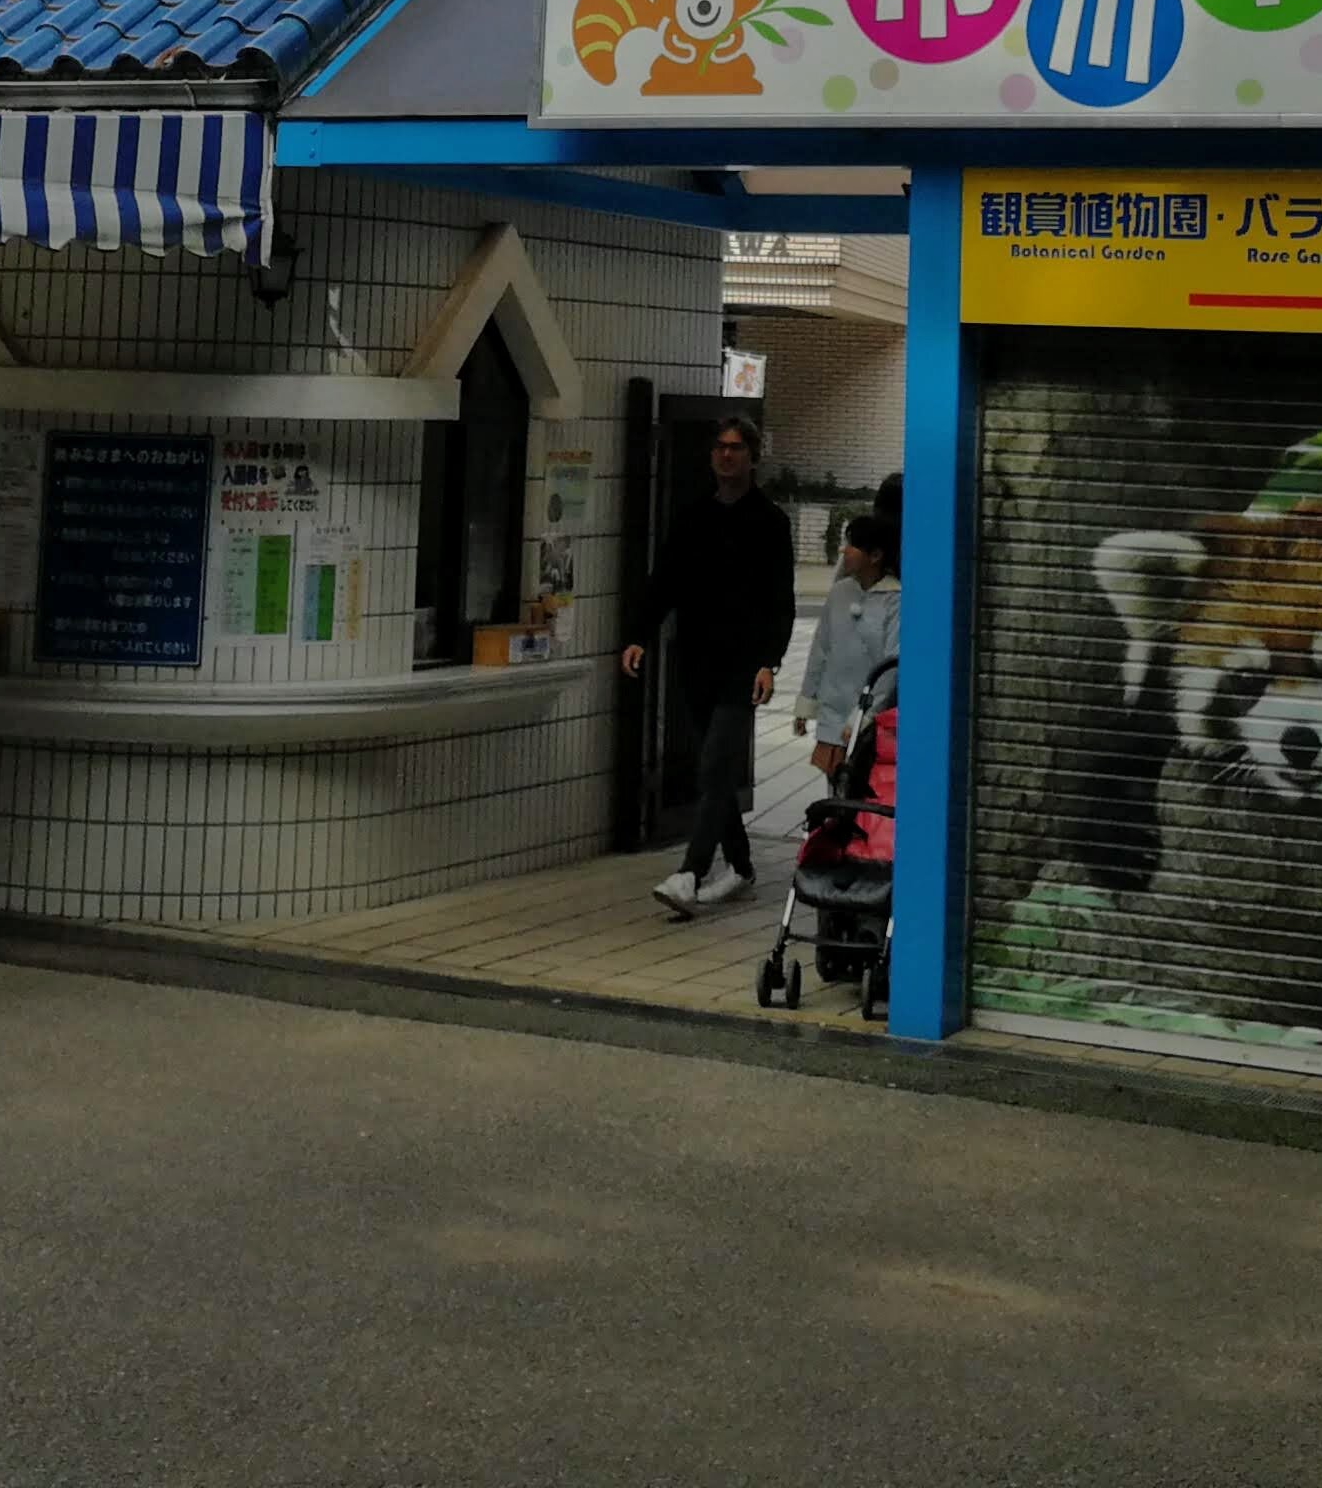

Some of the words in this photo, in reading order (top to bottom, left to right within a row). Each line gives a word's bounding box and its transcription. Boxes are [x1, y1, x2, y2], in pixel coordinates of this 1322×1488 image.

[1010, 244, 1096, 260] Botanical
[1101, 244, 1166, 262] Garden
[1246, 247, 1290, 264] Rose
